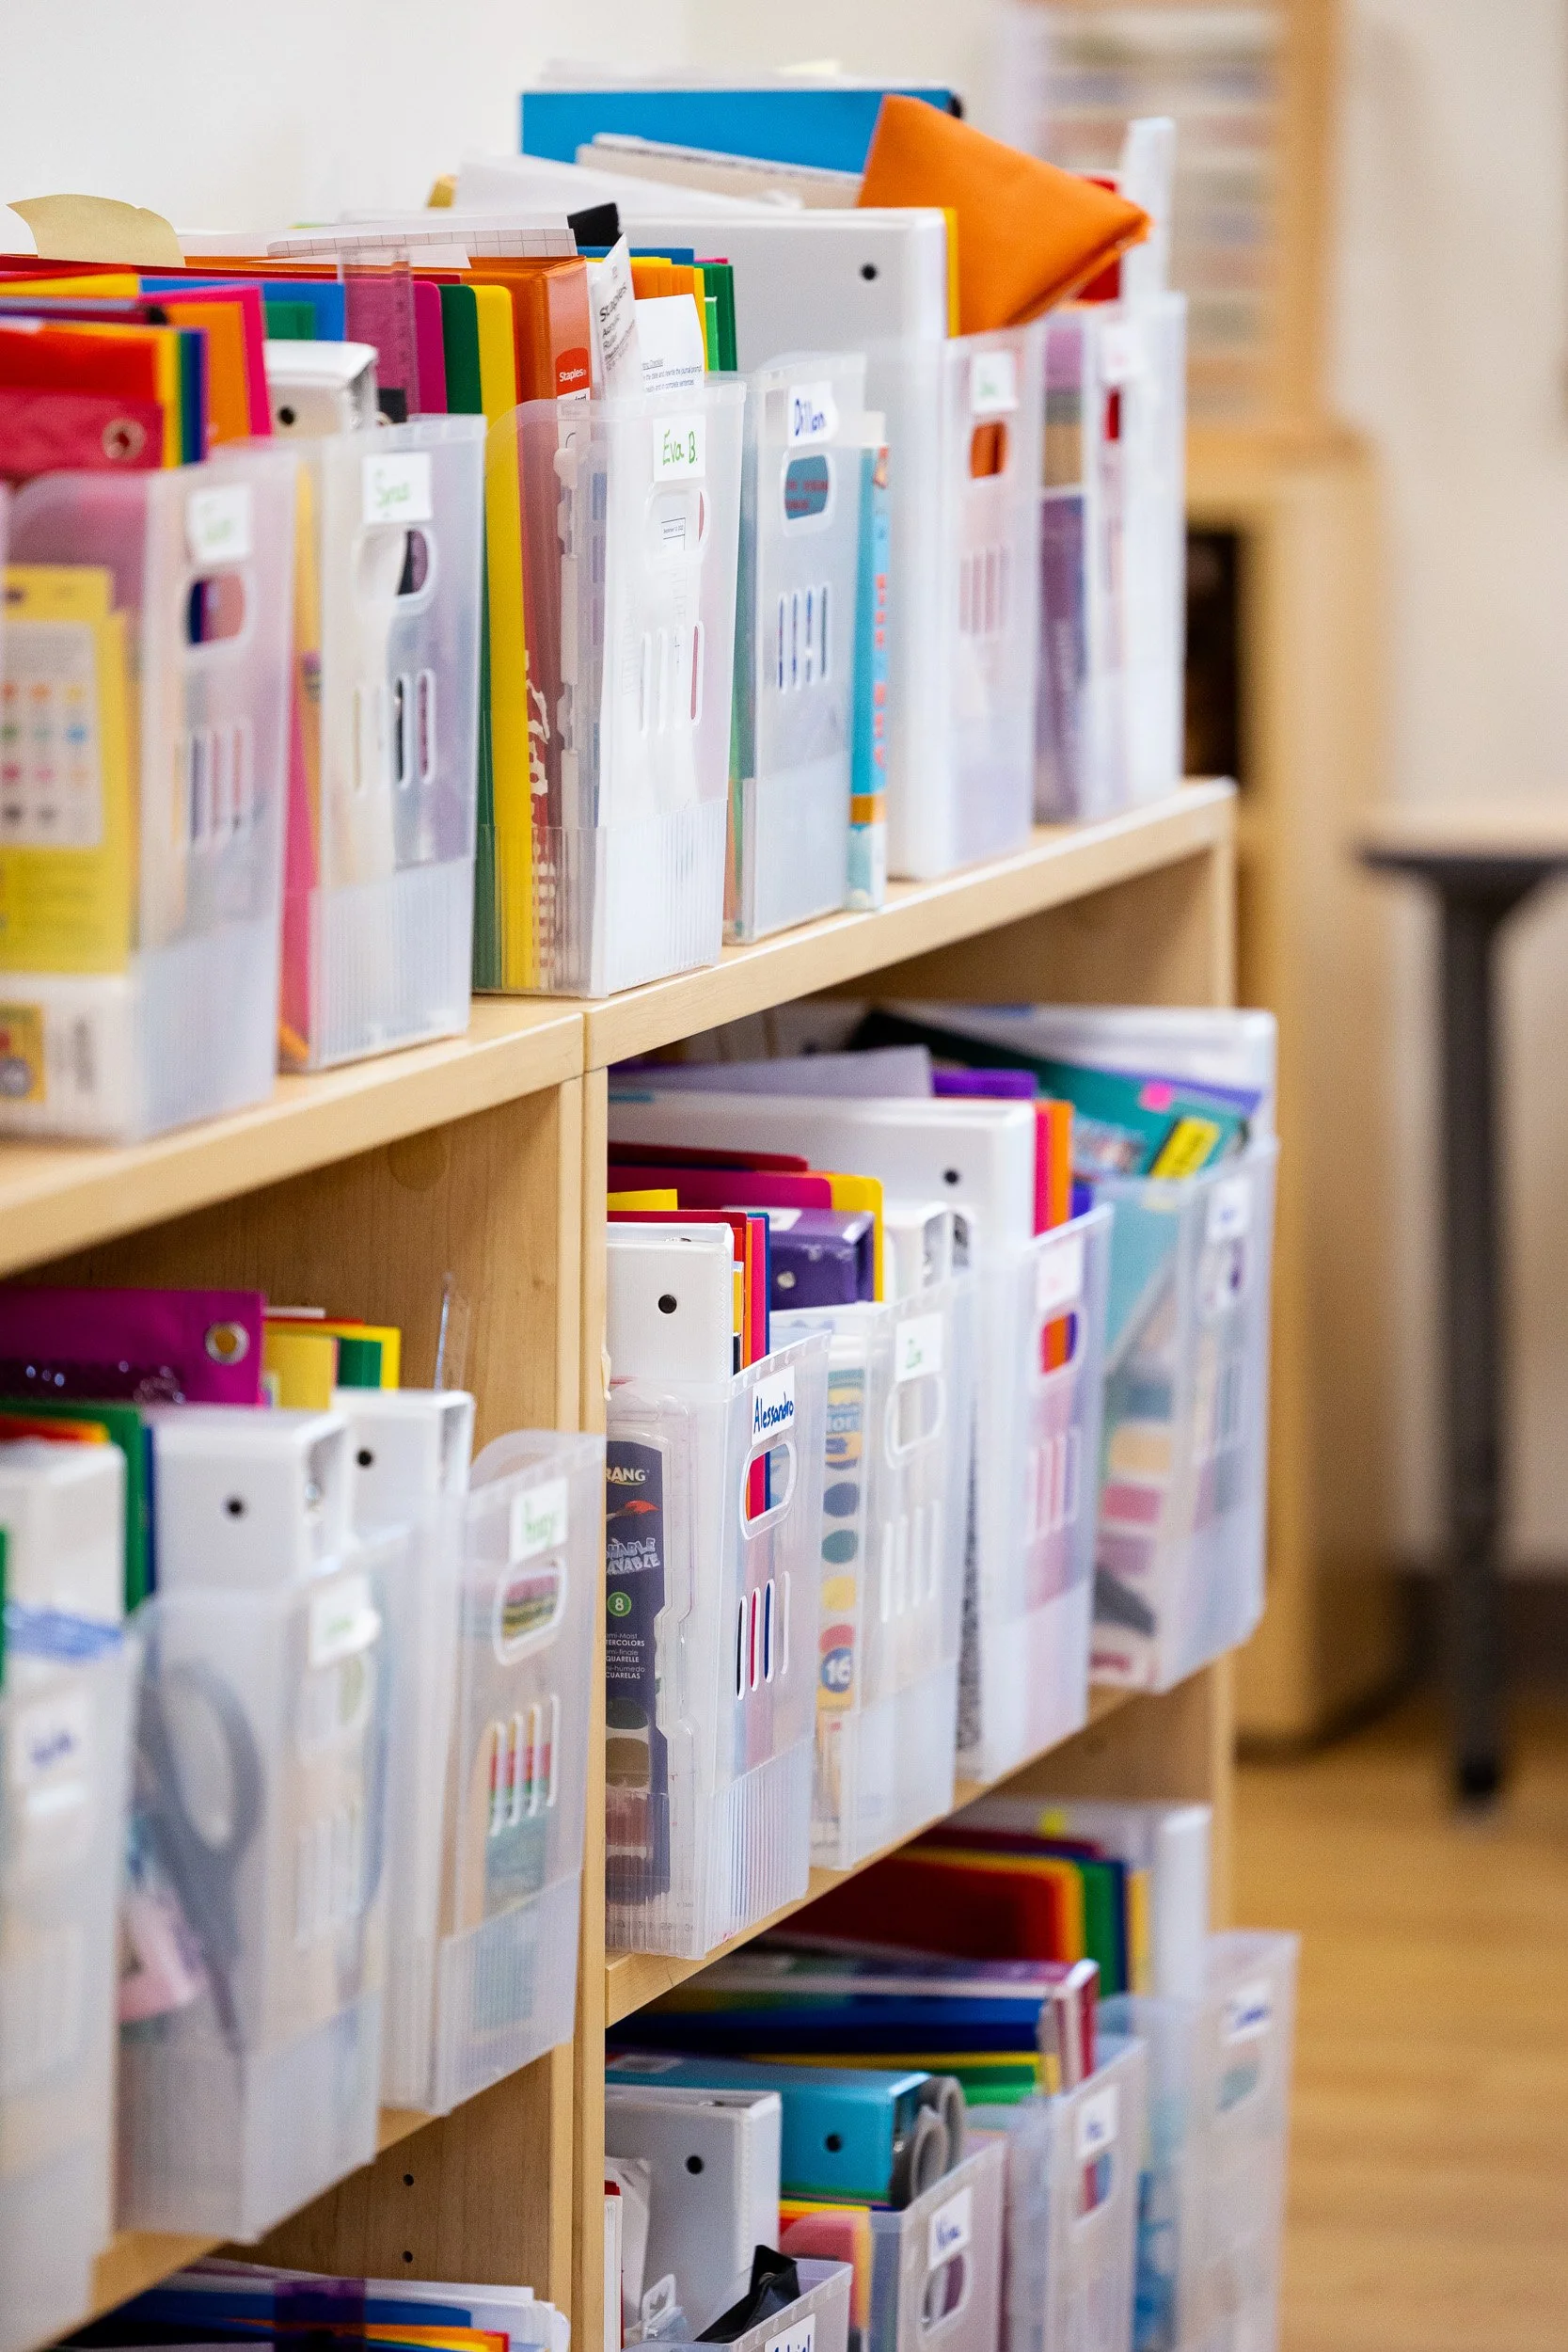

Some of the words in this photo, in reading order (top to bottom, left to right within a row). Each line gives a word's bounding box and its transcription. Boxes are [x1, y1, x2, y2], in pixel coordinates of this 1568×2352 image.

[662, 429, 685, 466] Eva
[689, 430, 698, 464] B.
[753, 1391, 794, 1435] Alessandro
[607, 1537, 656, 1560] HABLE
[615, 1597, 625, 1612] 8
